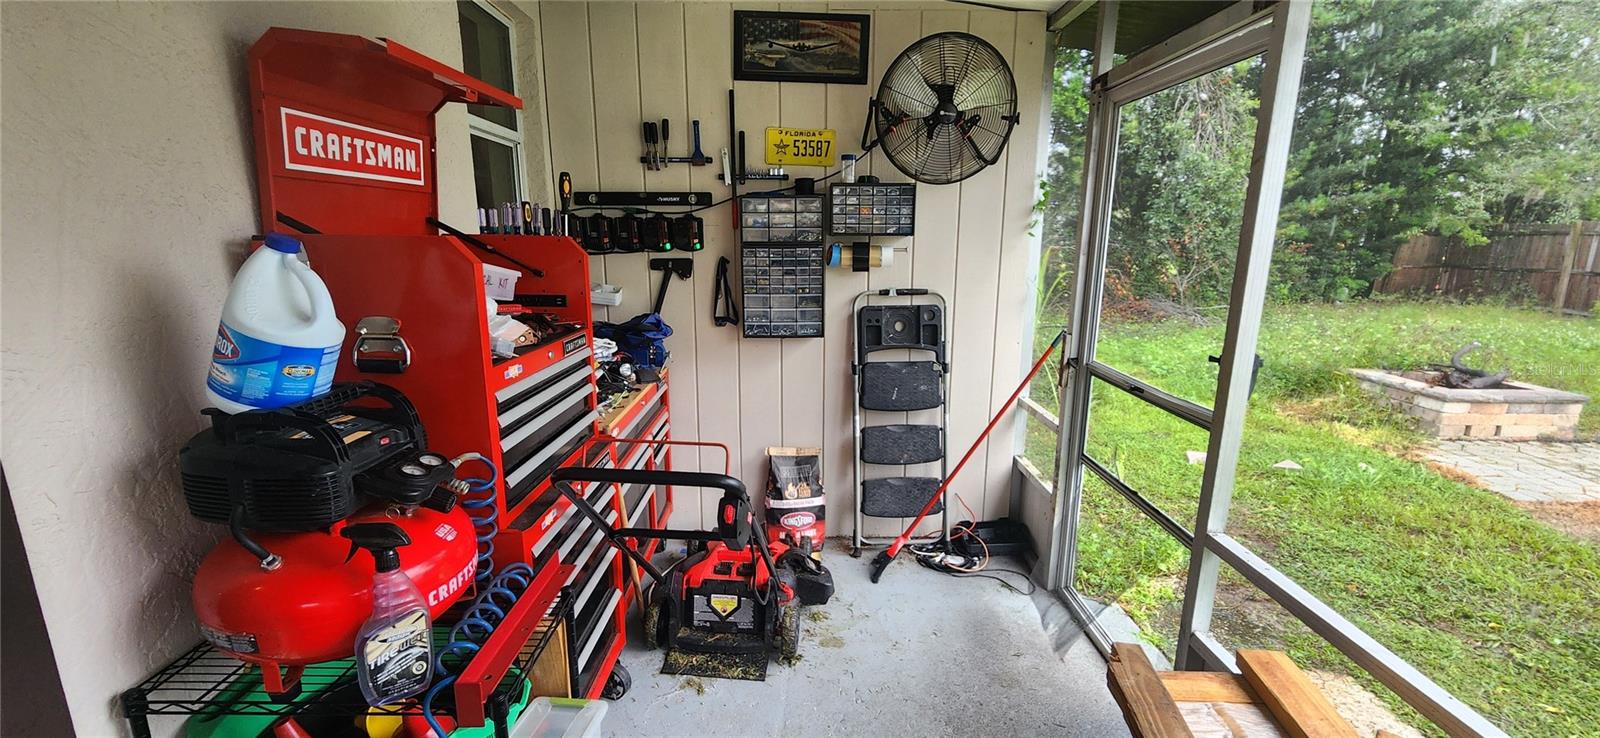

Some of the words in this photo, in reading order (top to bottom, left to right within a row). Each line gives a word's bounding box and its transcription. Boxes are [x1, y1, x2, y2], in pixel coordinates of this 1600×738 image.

[294, 126, 417, 173] CRAFTSMAN
[793, 139, 831, 158] 53587
[216, 335, 234, 357] ROX
[368, 646, 399, 670] TIRE
